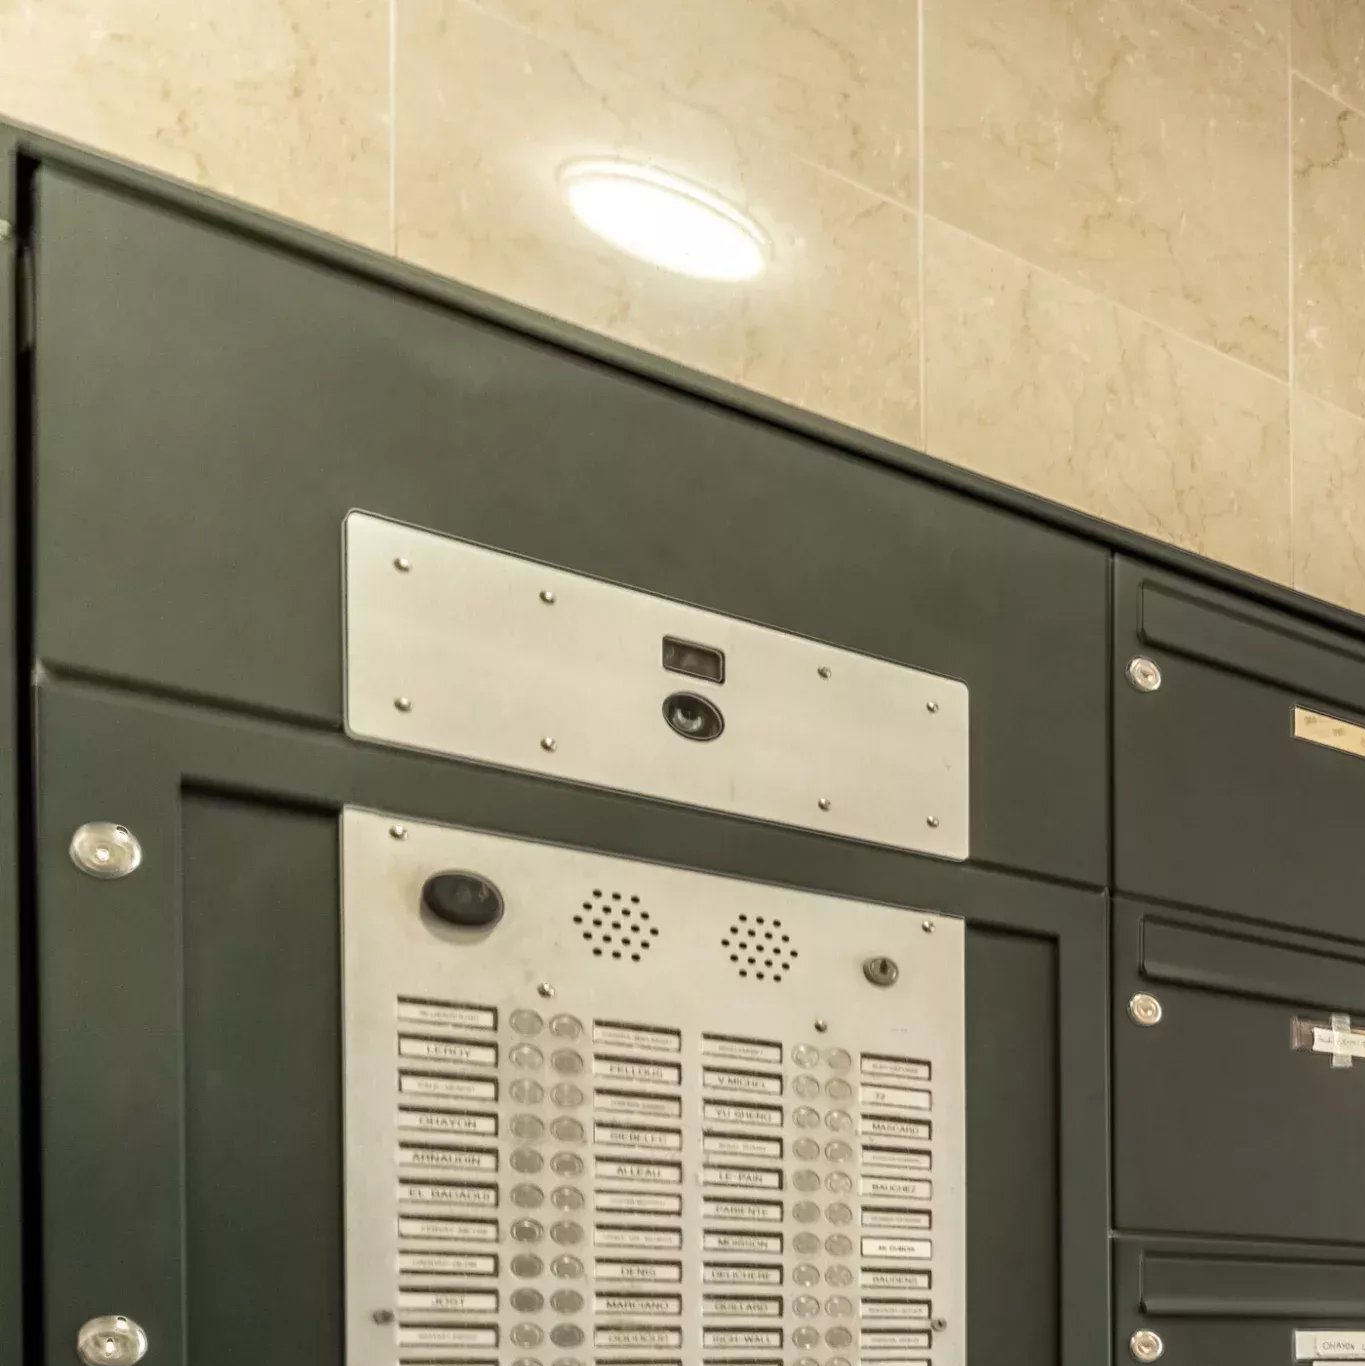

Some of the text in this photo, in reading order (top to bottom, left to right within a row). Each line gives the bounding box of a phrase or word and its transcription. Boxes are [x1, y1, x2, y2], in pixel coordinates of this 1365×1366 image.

[609, 1064, 664, 1078] FELLOUS
[621, 1267, 656, 1277] DENIS
[606, 1300, 669, 1311] MARCIANO
